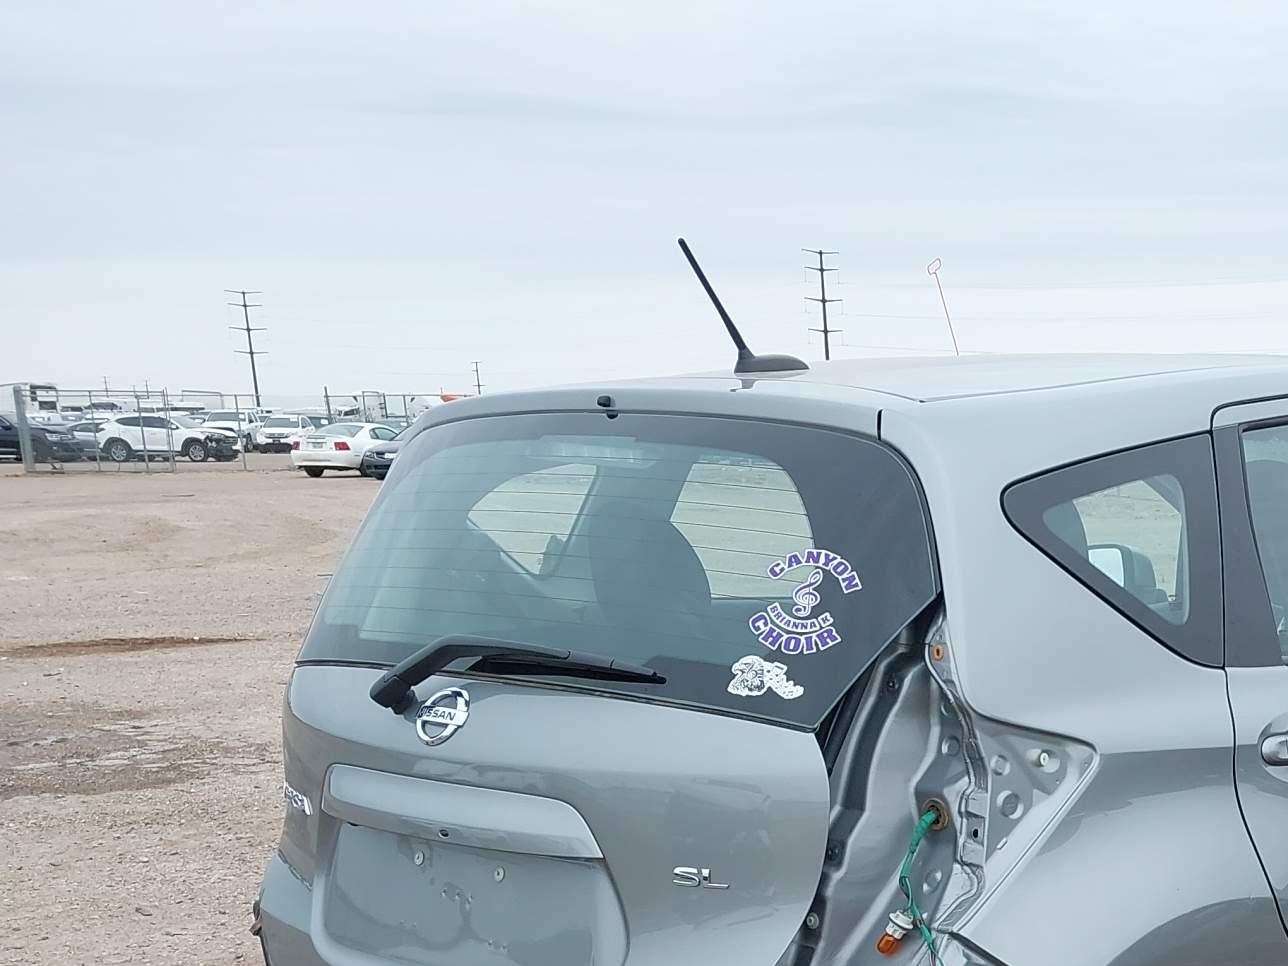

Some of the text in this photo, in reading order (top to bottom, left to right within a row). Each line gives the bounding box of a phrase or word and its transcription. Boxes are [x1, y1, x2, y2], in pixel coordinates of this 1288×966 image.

[768, 549, 862, 594] CANYON
[767, 602, 834, 632] BRIANNA K
[750, 612, 841, 654] CHOIR
[416, 705, 457, 722] NISSAN
[672, 866, 730, 890] SL
